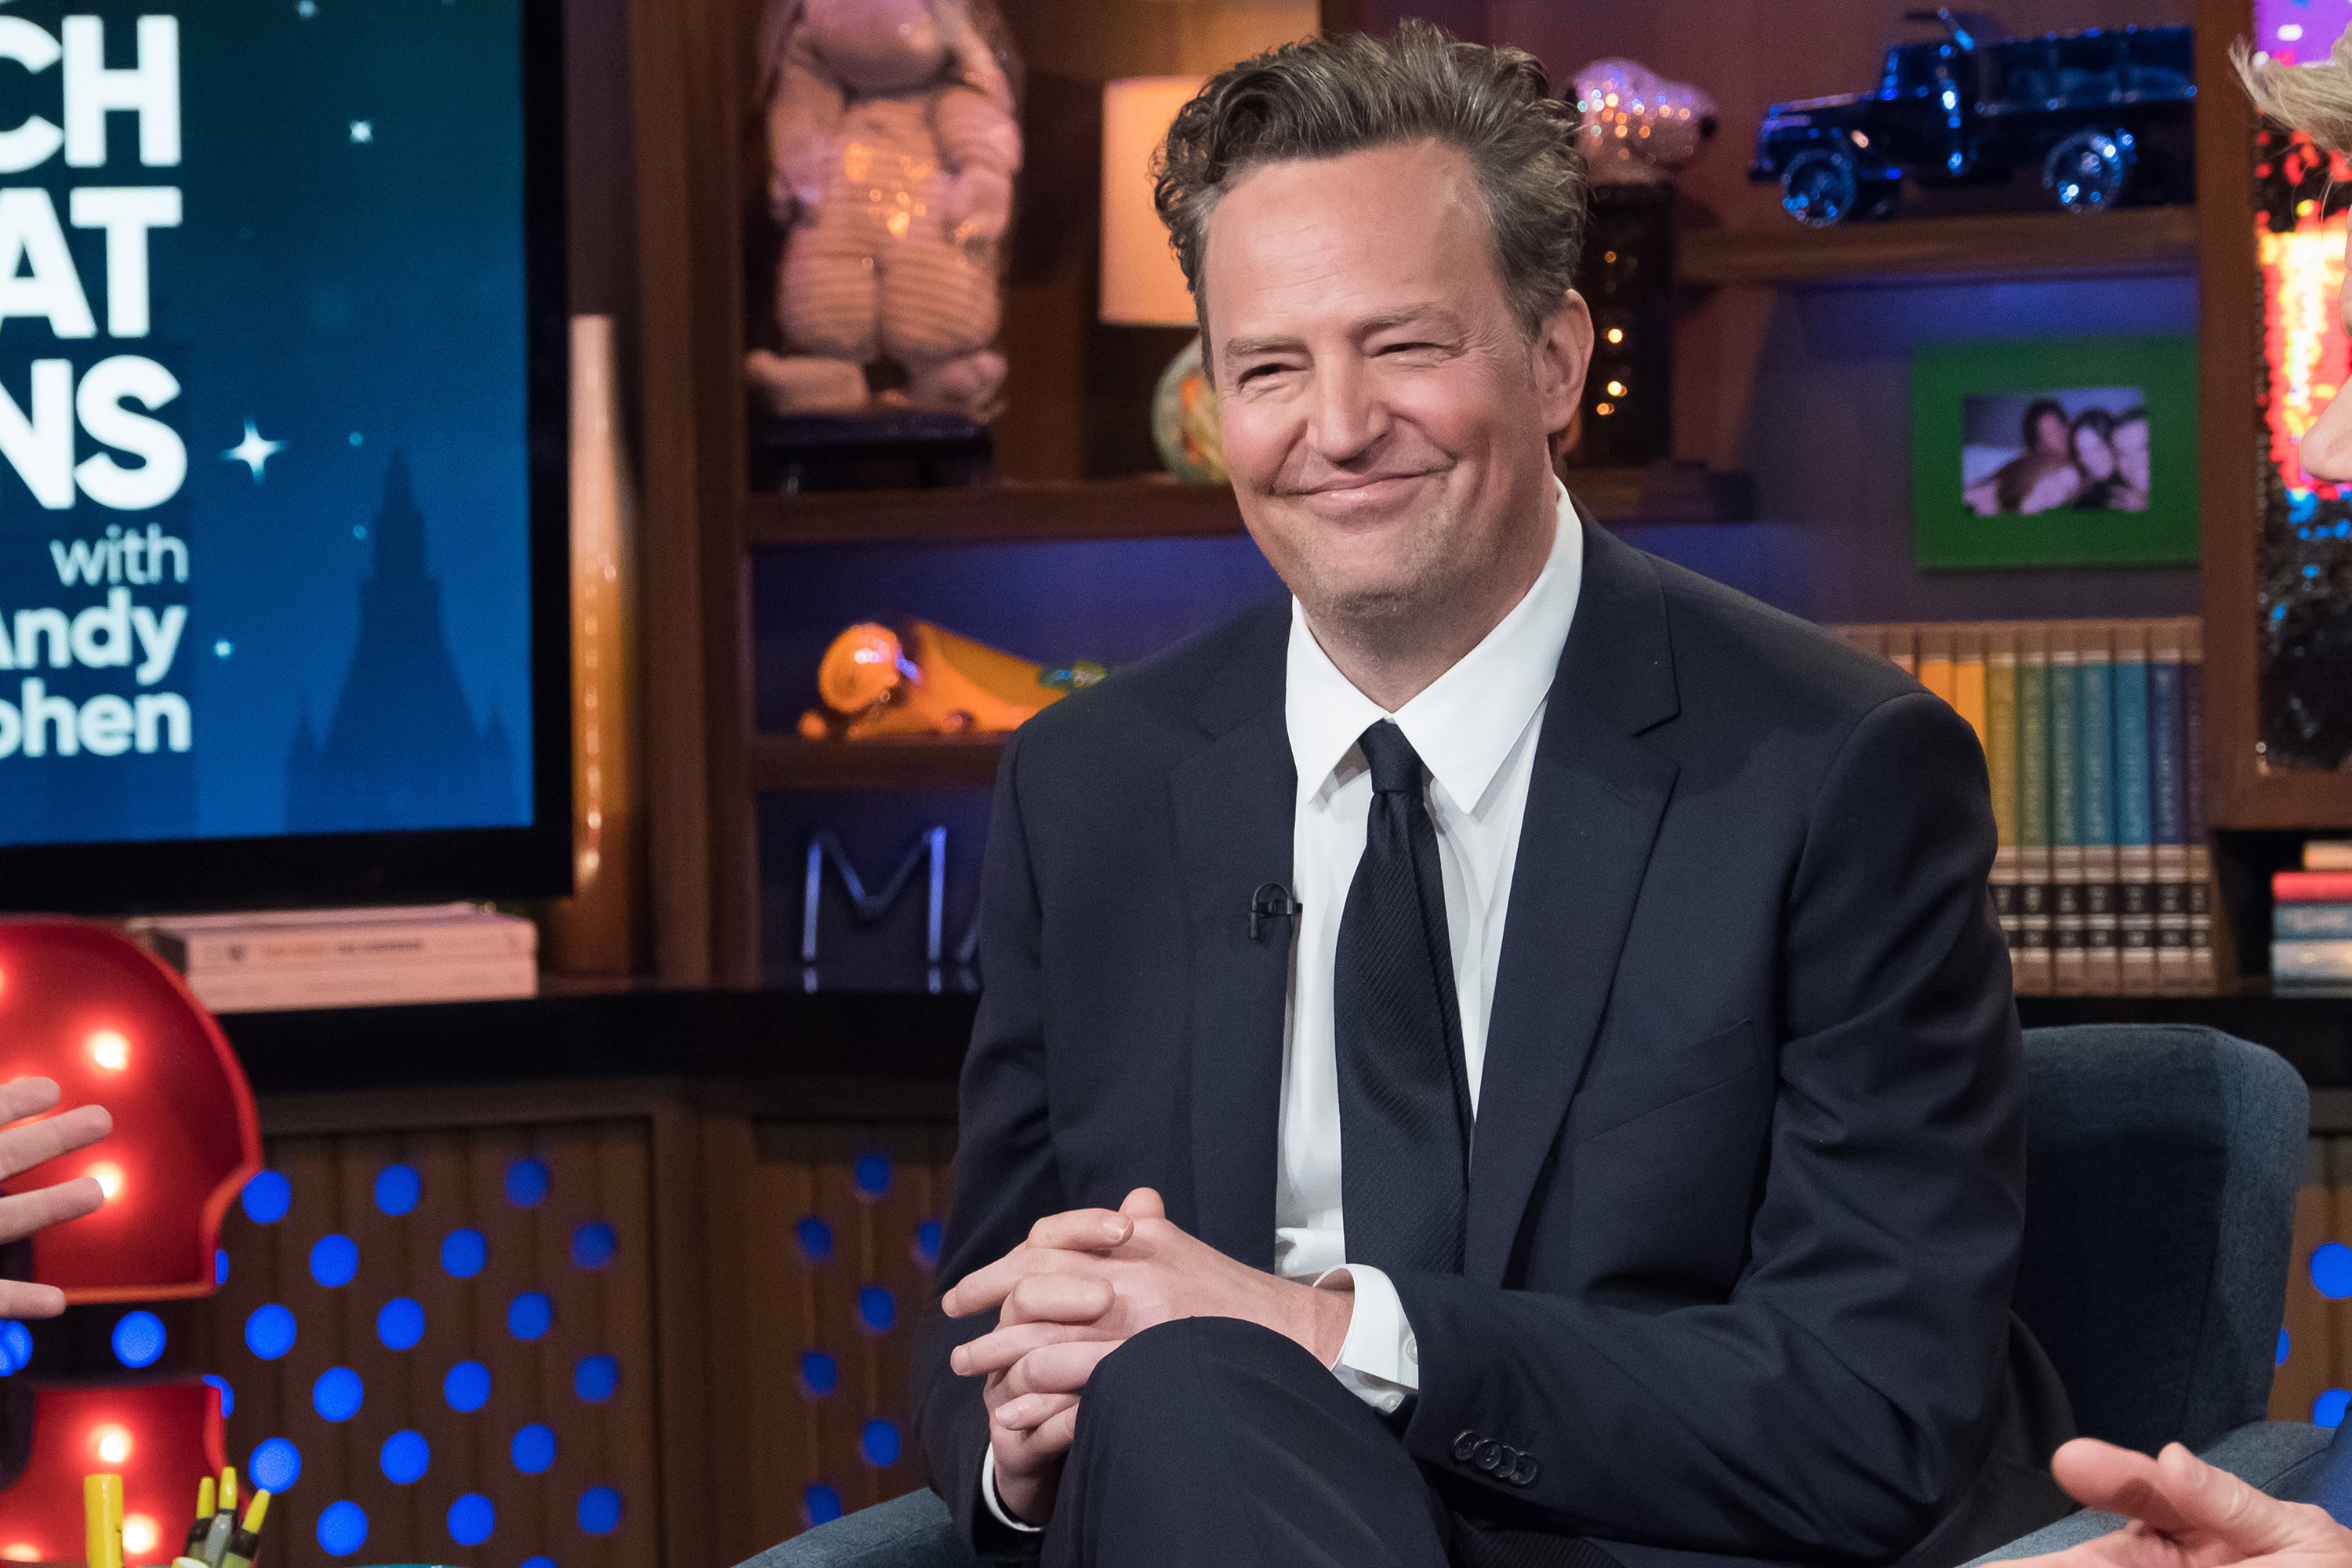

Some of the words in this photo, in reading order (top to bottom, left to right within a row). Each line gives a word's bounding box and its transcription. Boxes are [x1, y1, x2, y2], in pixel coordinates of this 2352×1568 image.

[0, 185, 183, 340] AT
[0, 354, 187, 510] NS
[49, 522, 190, 586] with
[0, 585, 188, 686] ndy
[802, 826, 982, 964] M
